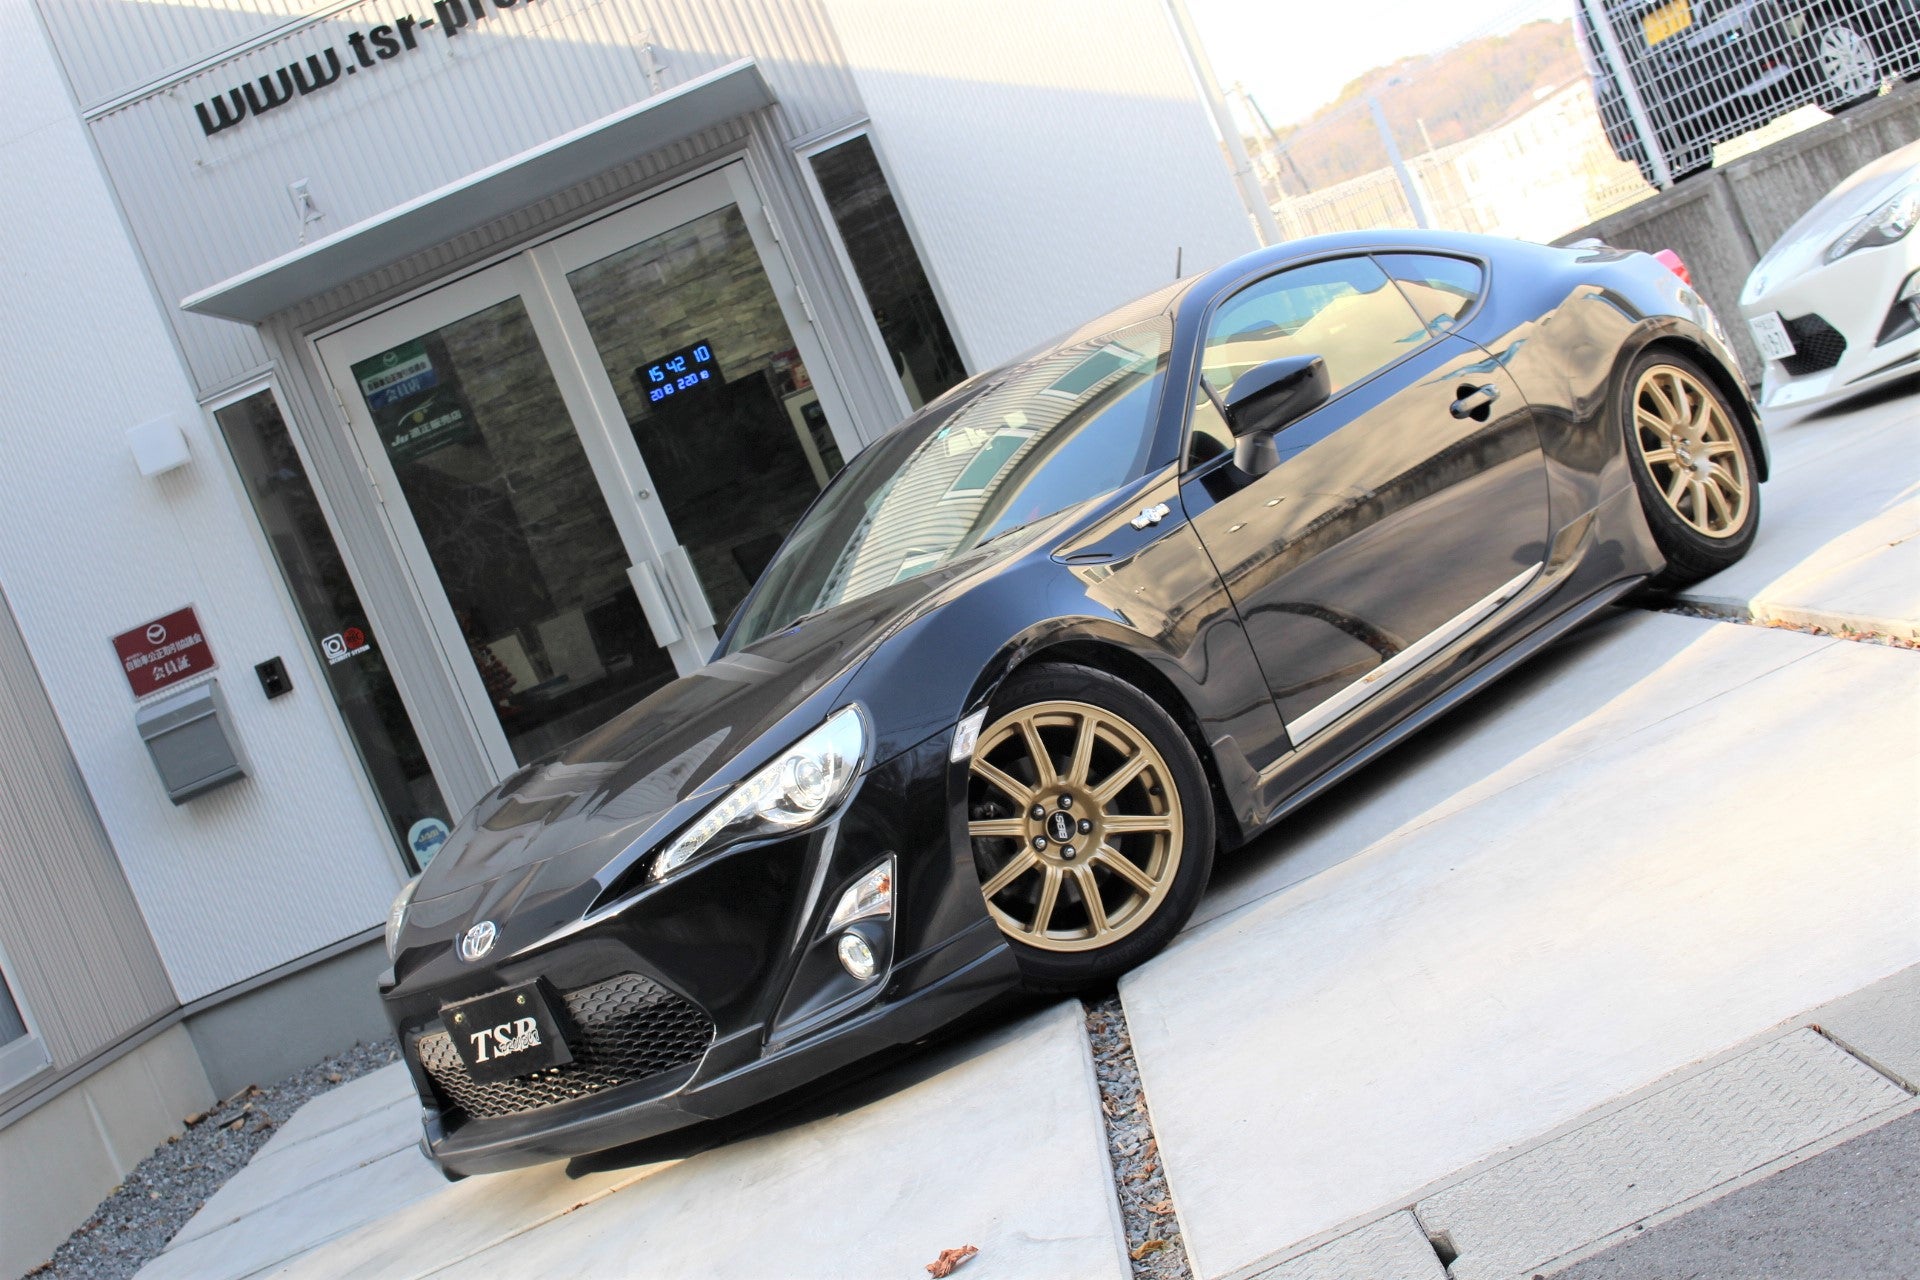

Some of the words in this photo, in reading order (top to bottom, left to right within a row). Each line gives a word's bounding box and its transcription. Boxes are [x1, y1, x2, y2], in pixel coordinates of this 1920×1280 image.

[648, 365, 665, 382] 15
[665, 356, 687, 373] 42
[693, 345, 711, 363] 10
[470, 1016, 542, 1064] TSR
